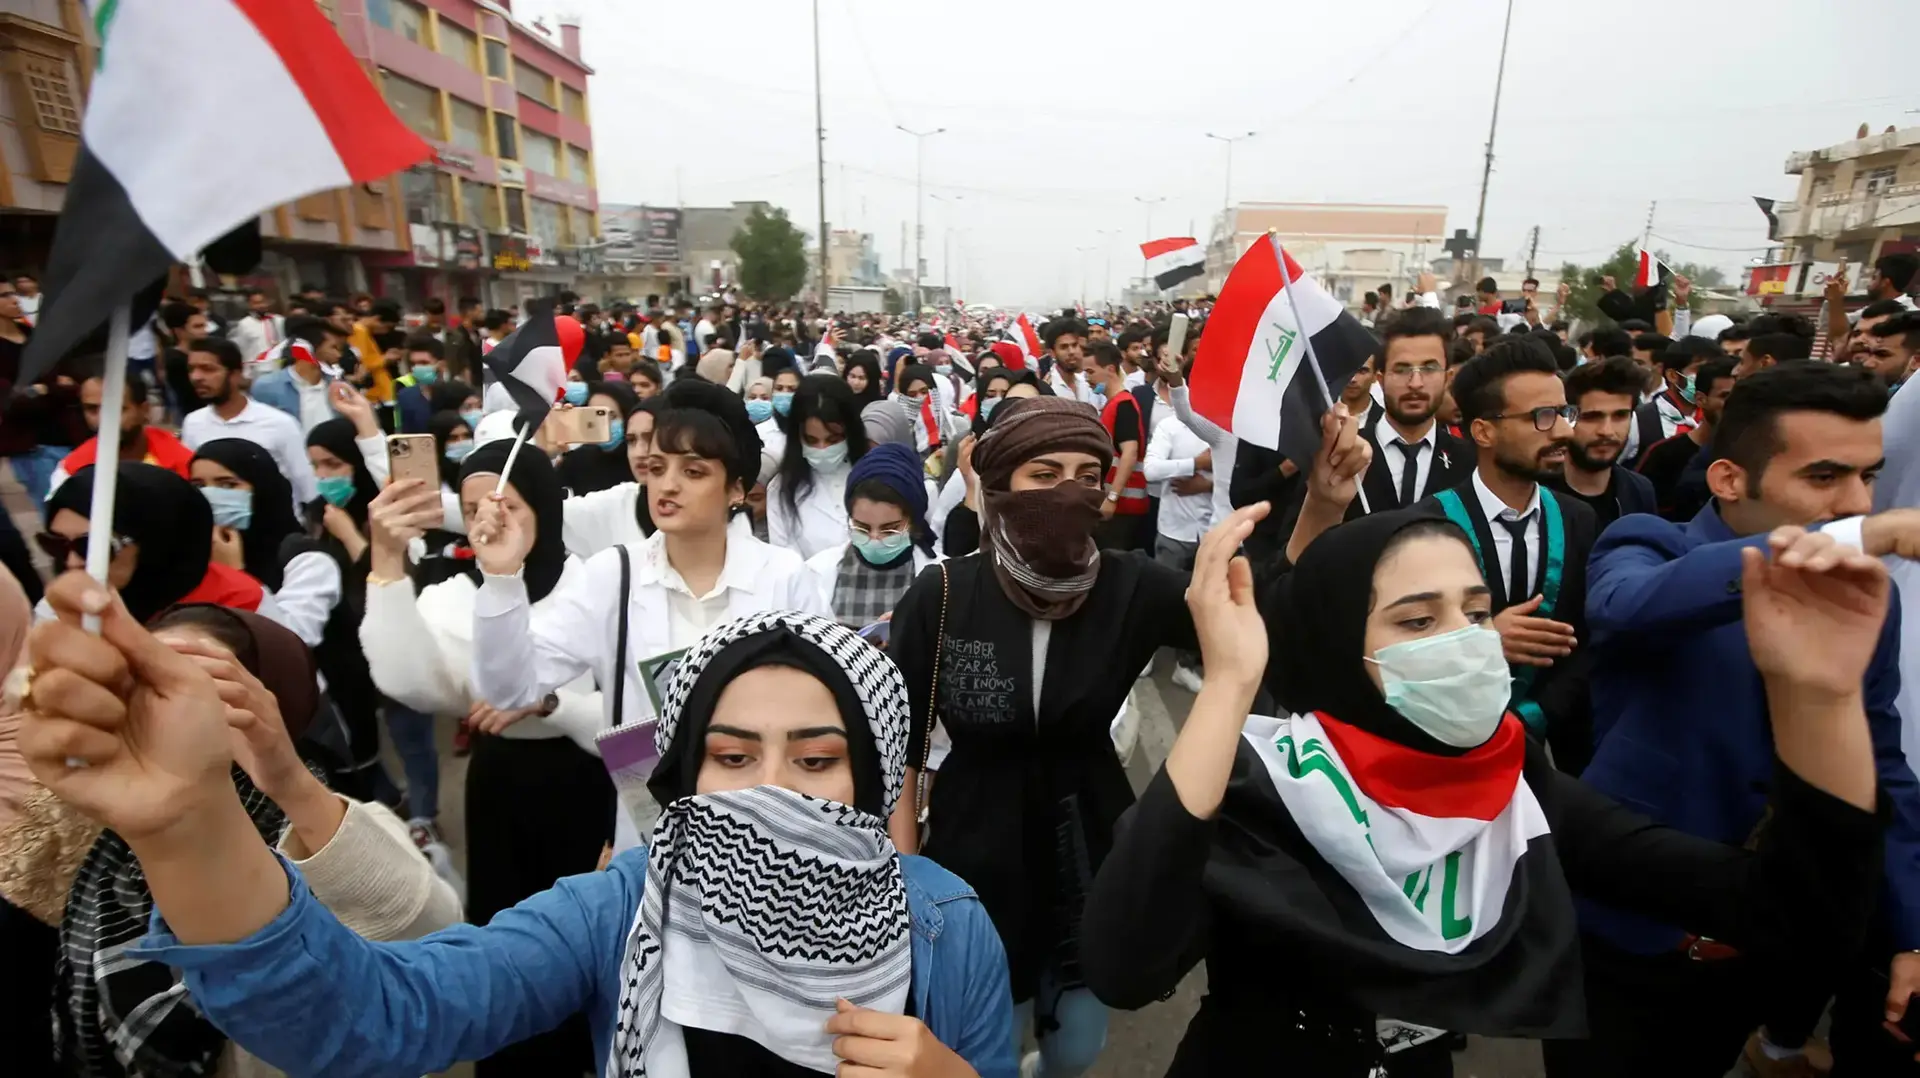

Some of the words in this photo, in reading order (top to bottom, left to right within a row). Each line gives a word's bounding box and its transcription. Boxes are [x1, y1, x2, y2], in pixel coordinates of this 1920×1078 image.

[954, 656, 980, 673] FAR
[984, 661, 998, 676] AS
[973, 677, 1015, 692] KNOWS
